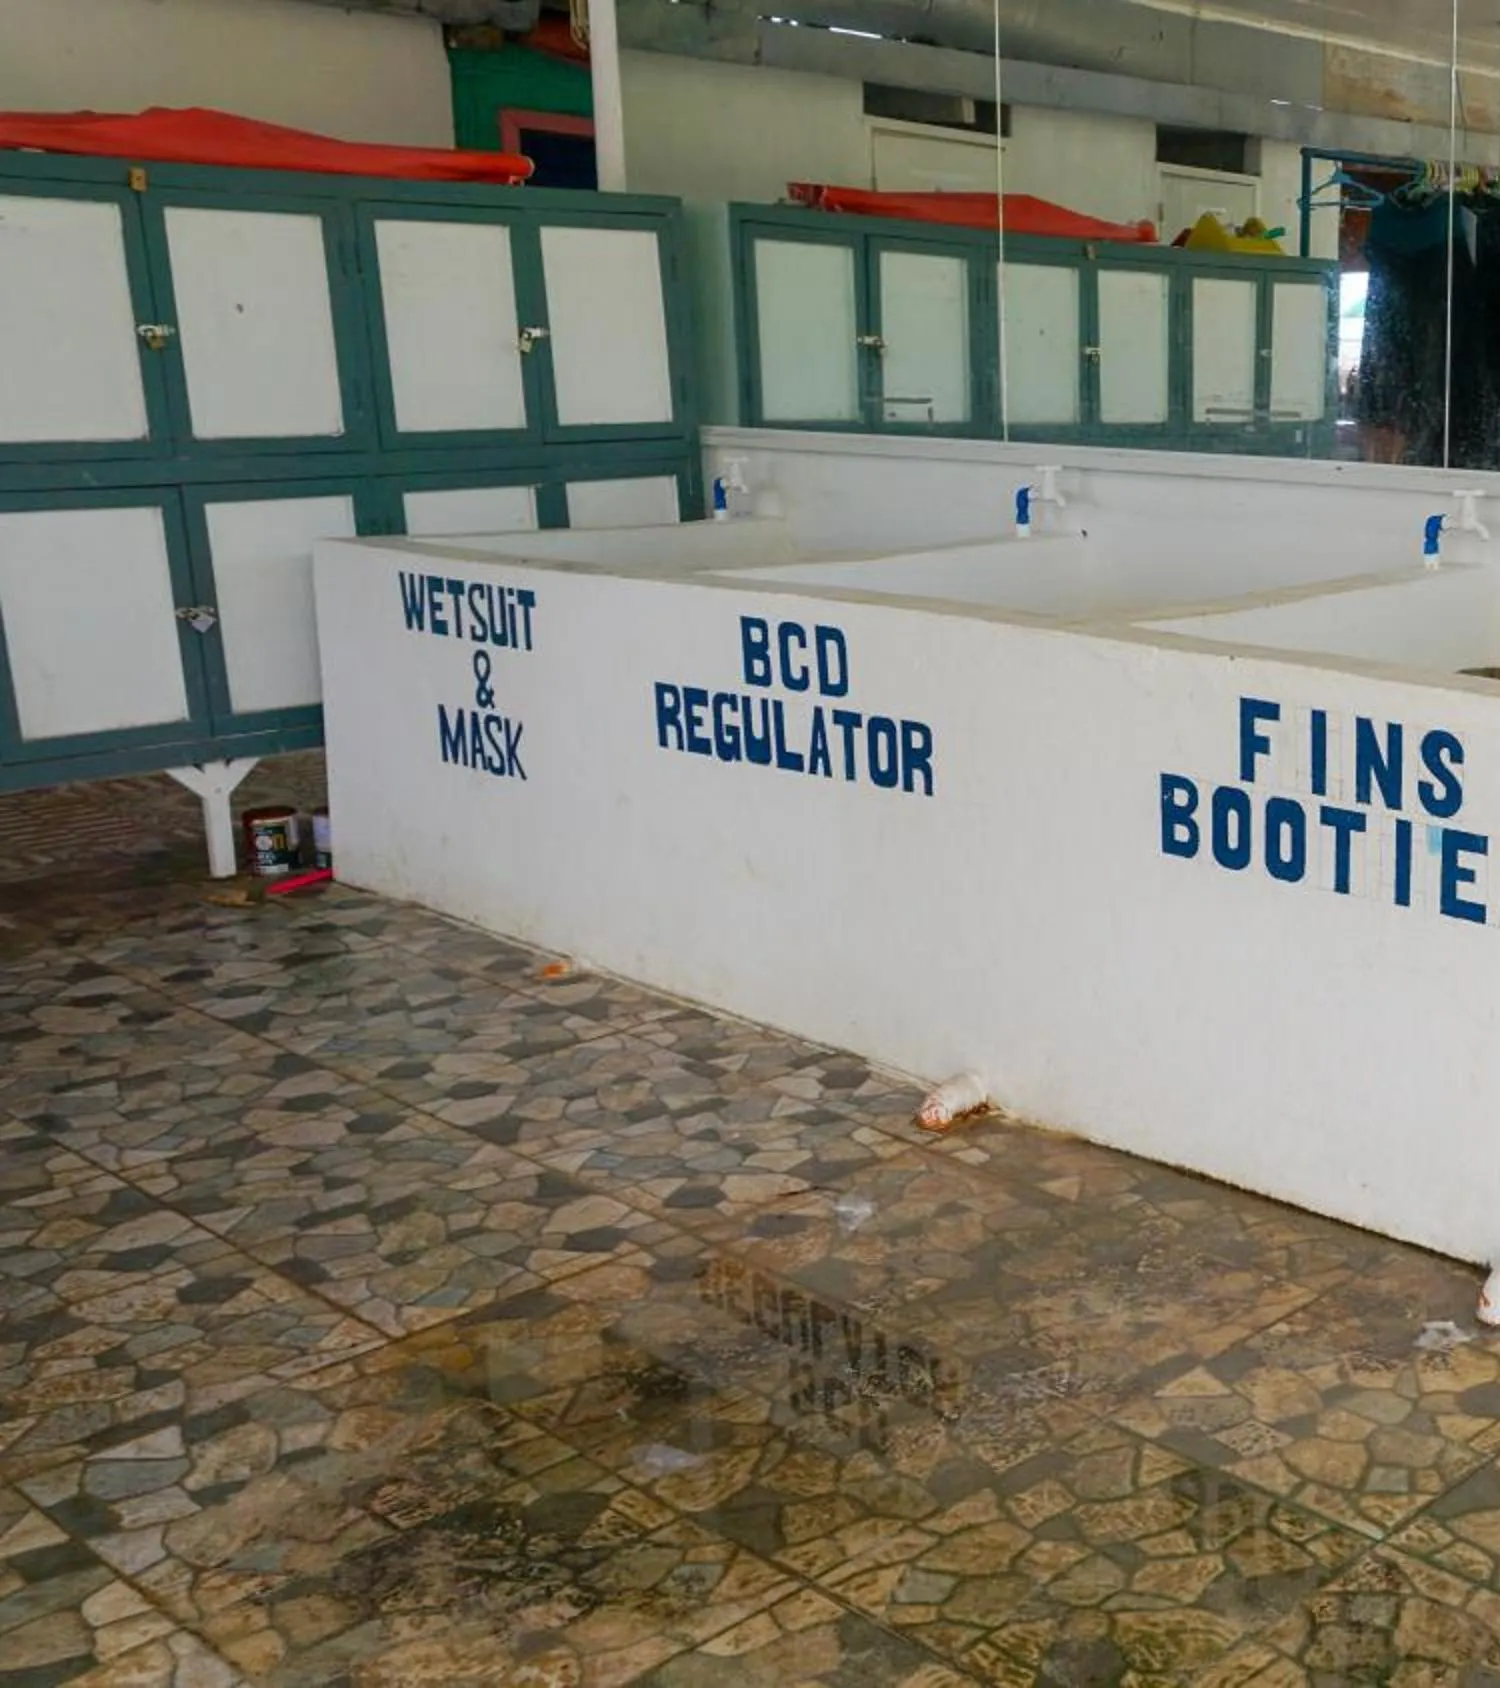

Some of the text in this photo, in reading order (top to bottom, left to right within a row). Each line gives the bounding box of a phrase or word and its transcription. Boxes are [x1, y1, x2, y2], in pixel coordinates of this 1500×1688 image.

[473, 649, 496, 709] &
[740, 615, 849, 698] BCD
[438, 703, 527, 780] MASK
[655, 682, 934, 796] REGULATOR
[1240, 697, 1465, 819] FINS
